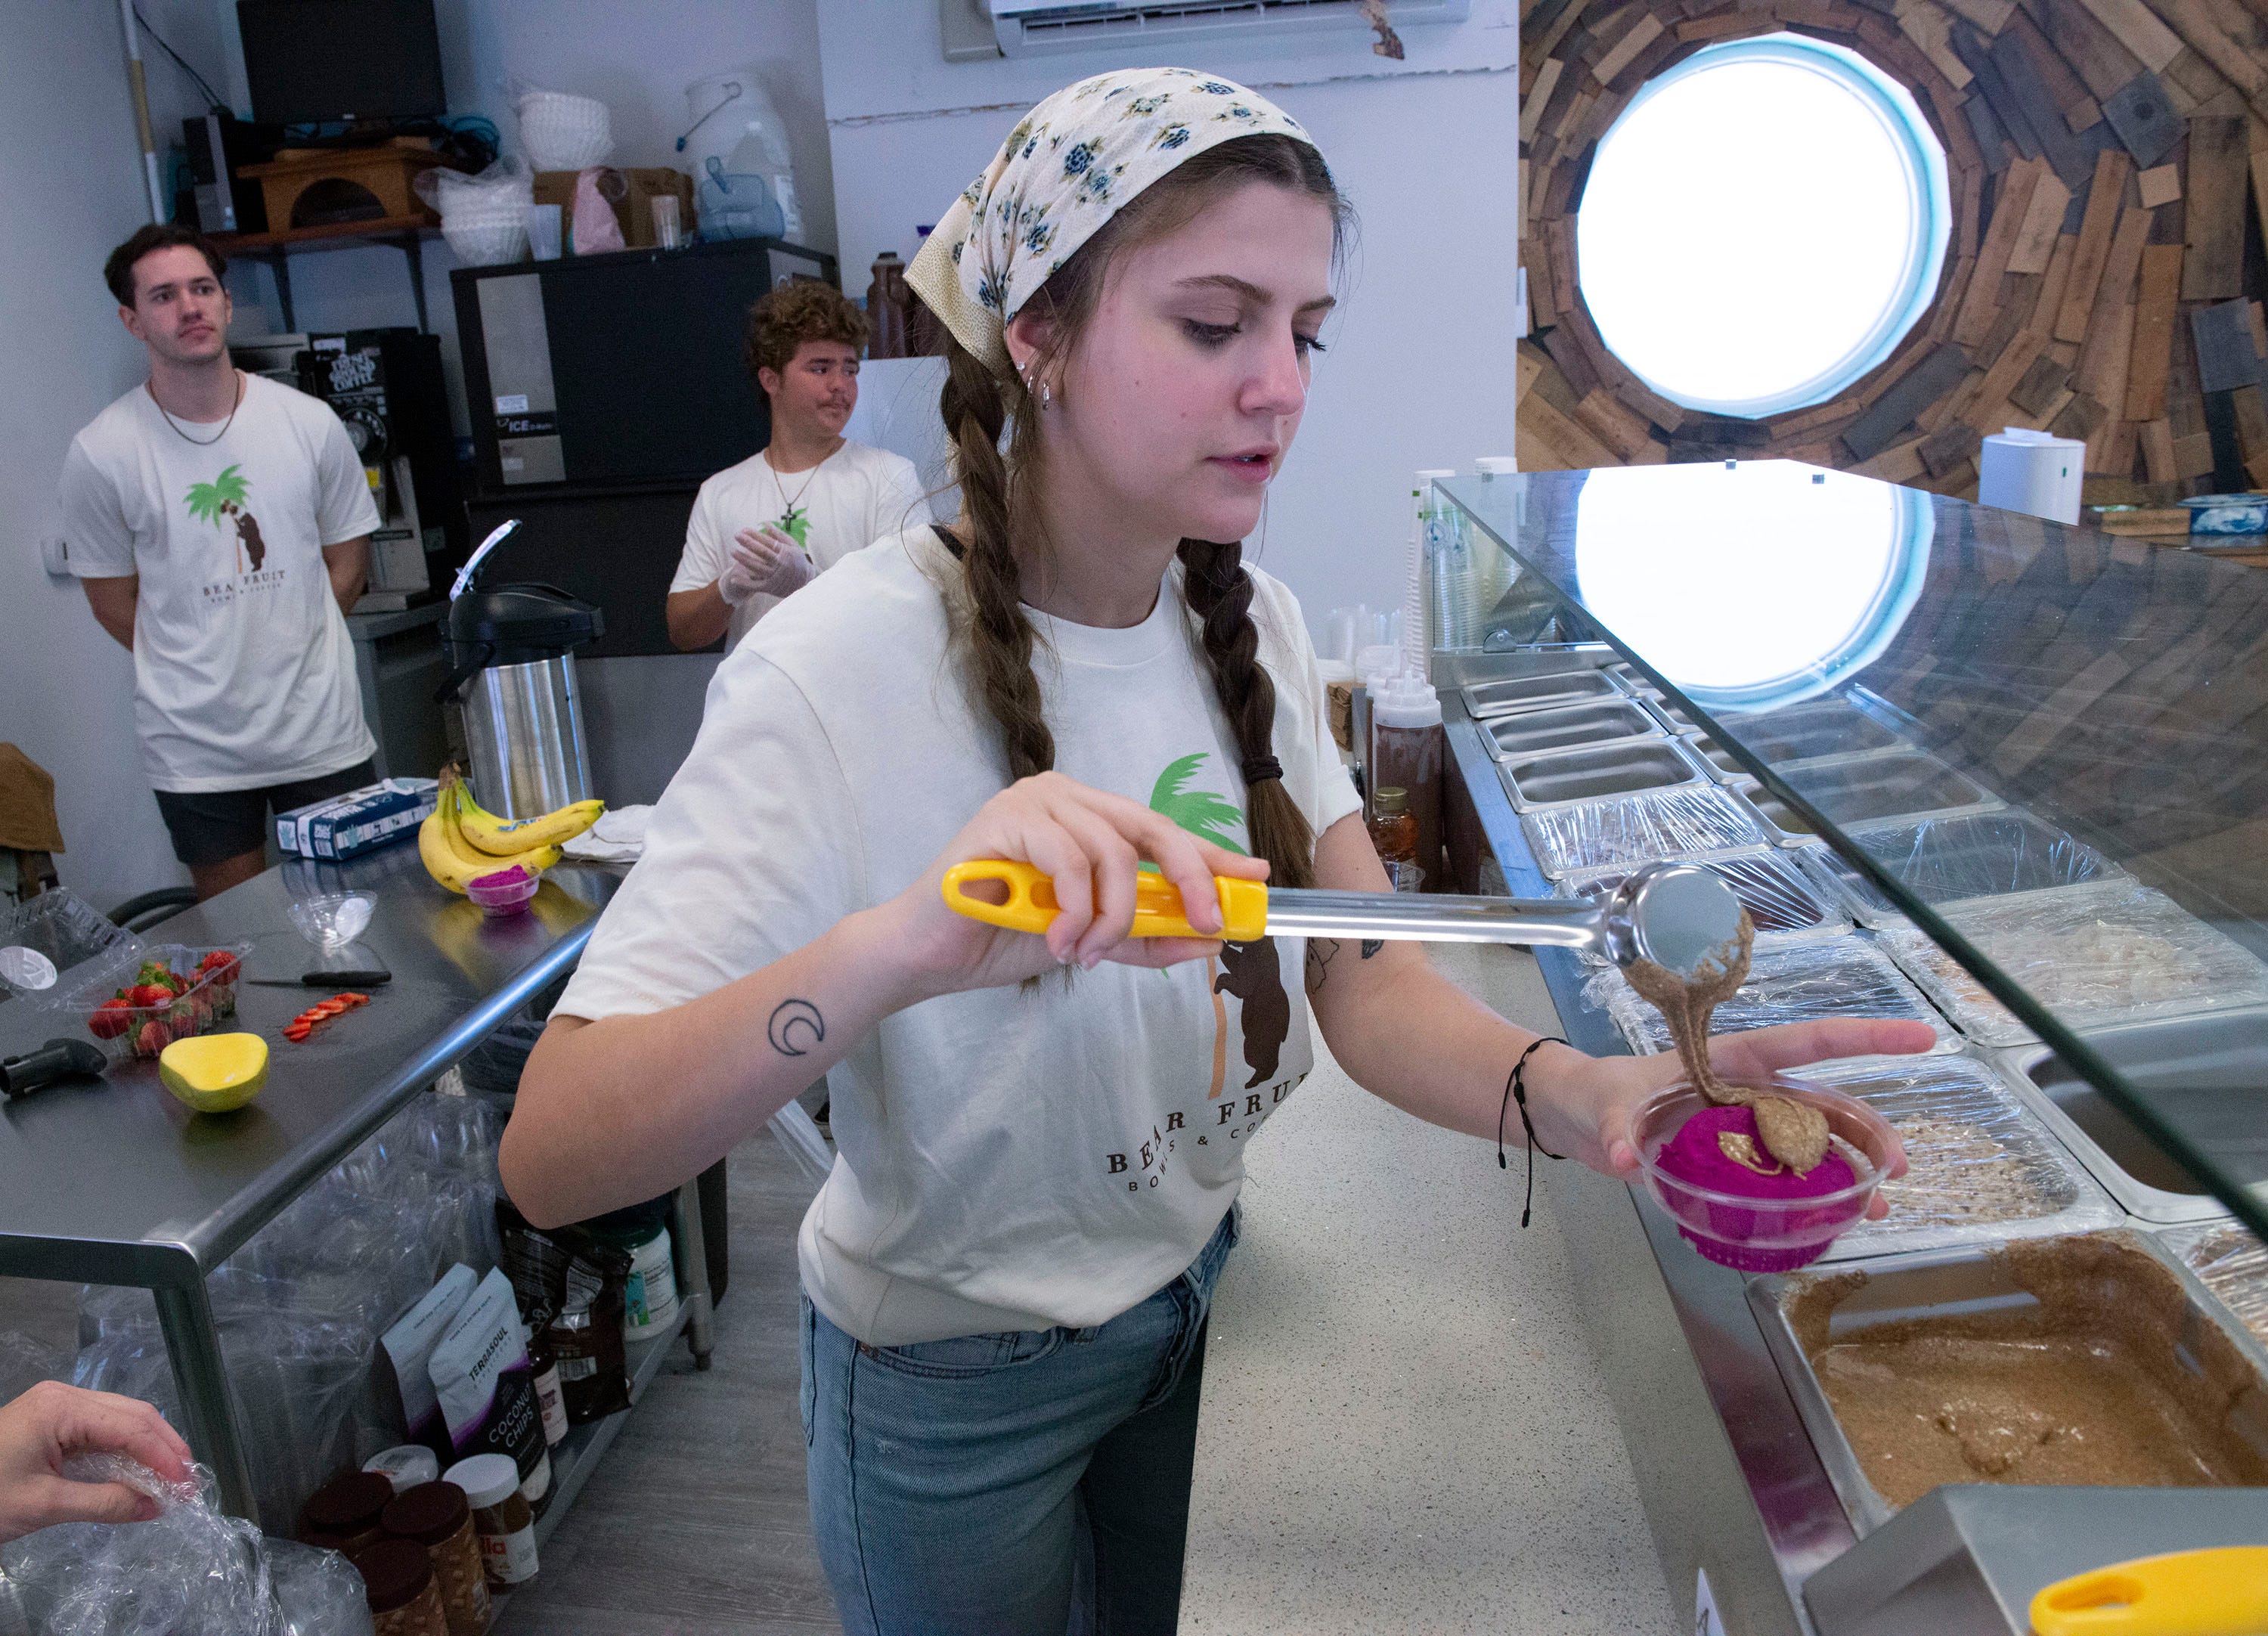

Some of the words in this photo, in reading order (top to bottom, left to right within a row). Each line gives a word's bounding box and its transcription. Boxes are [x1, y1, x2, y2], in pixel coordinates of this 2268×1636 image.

[509, 420, 528, 432] ICE
[243, 569, 285, 585] FRUIT
[1106, 1112, 1186, 1174] BEAR
[1129, 1139, 1175, 1191] BOWLS
[1198, 1136, 1208, 1146] &
[468, 1327, 509, 1382] TERRASOUL
[506, 1406, 534, 1448] CHIPS
